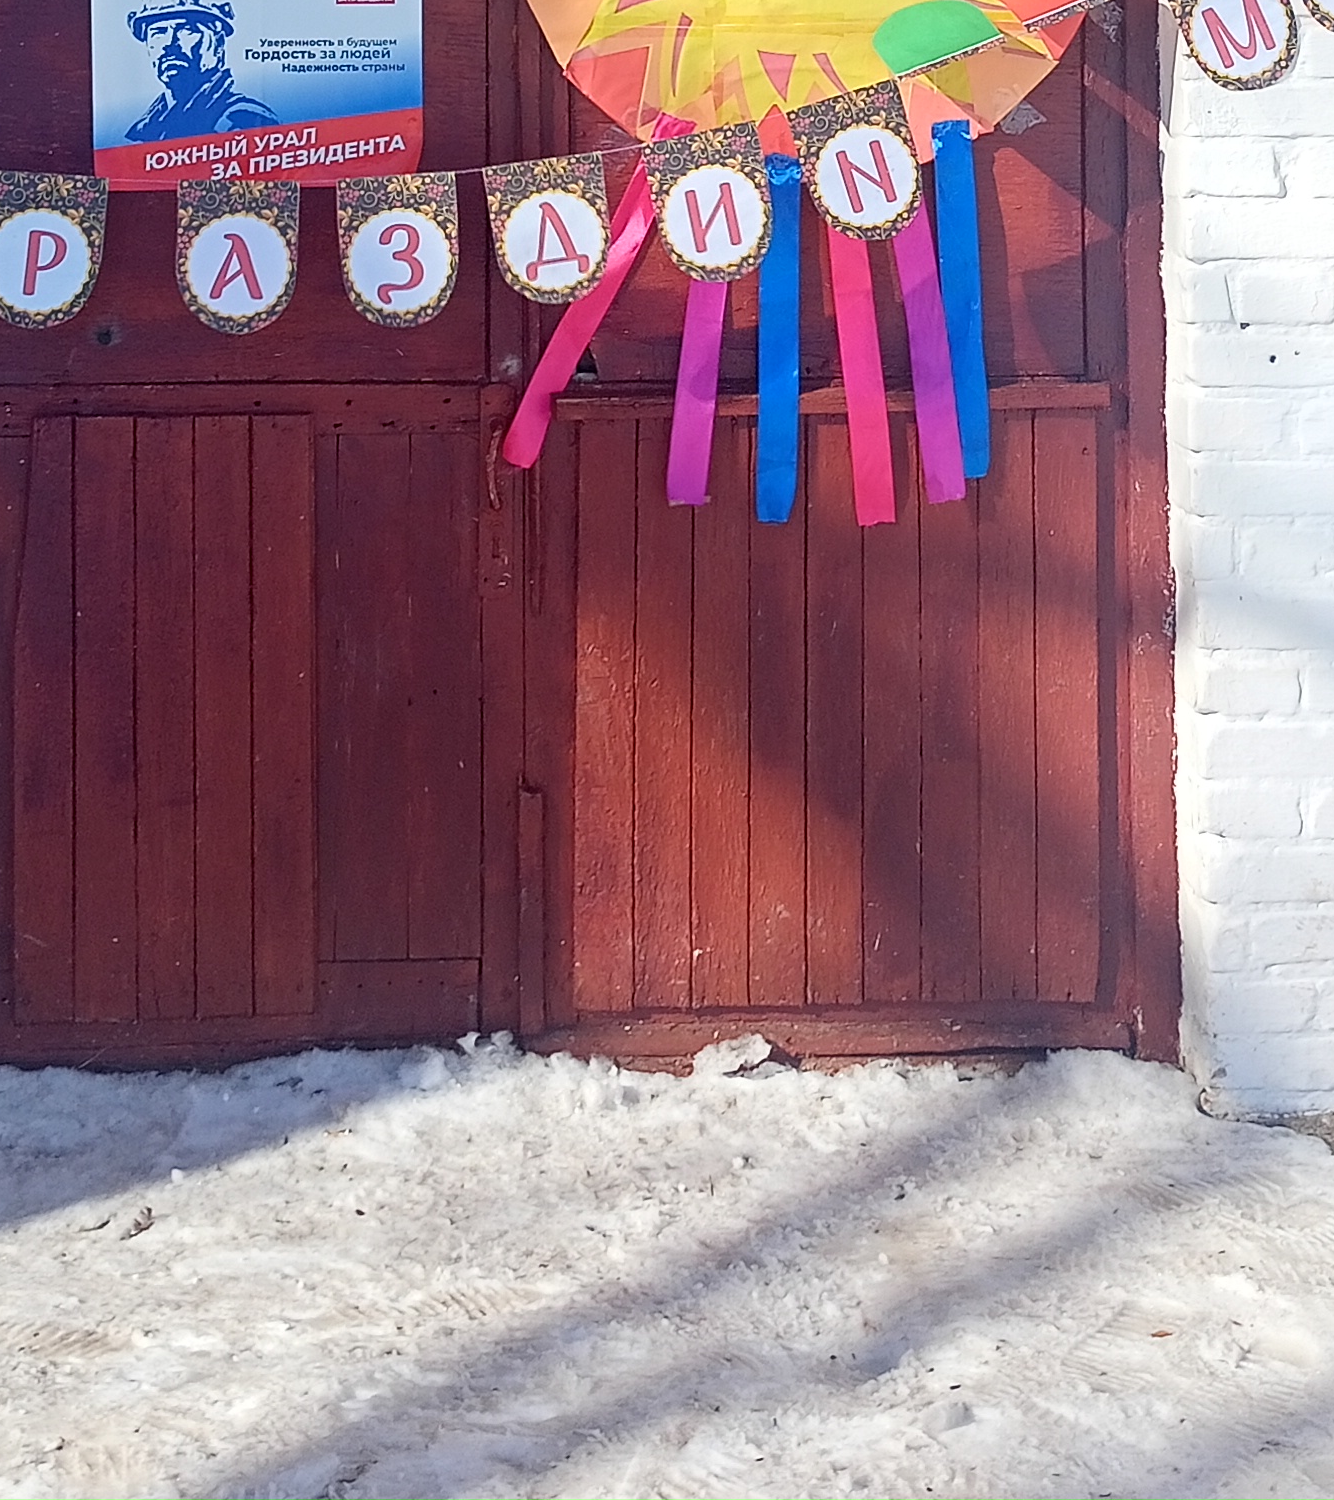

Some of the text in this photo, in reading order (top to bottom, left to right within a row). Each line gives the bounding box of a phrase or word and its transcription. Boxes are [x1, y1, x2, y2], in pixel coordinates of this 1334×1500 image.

[259, 38, 335, 49] Уверенность
[346, 37, 398, 49] будущем
[244, 47, 391, 62] Гордость за людей
[281, 63, 406, 73] Надежность страны
[145, 127, 318, 171] ЮЖНЫЙ УРАЛ
[210, 134, 406, 180] ЗА ПРЕЗИДЕНТА
